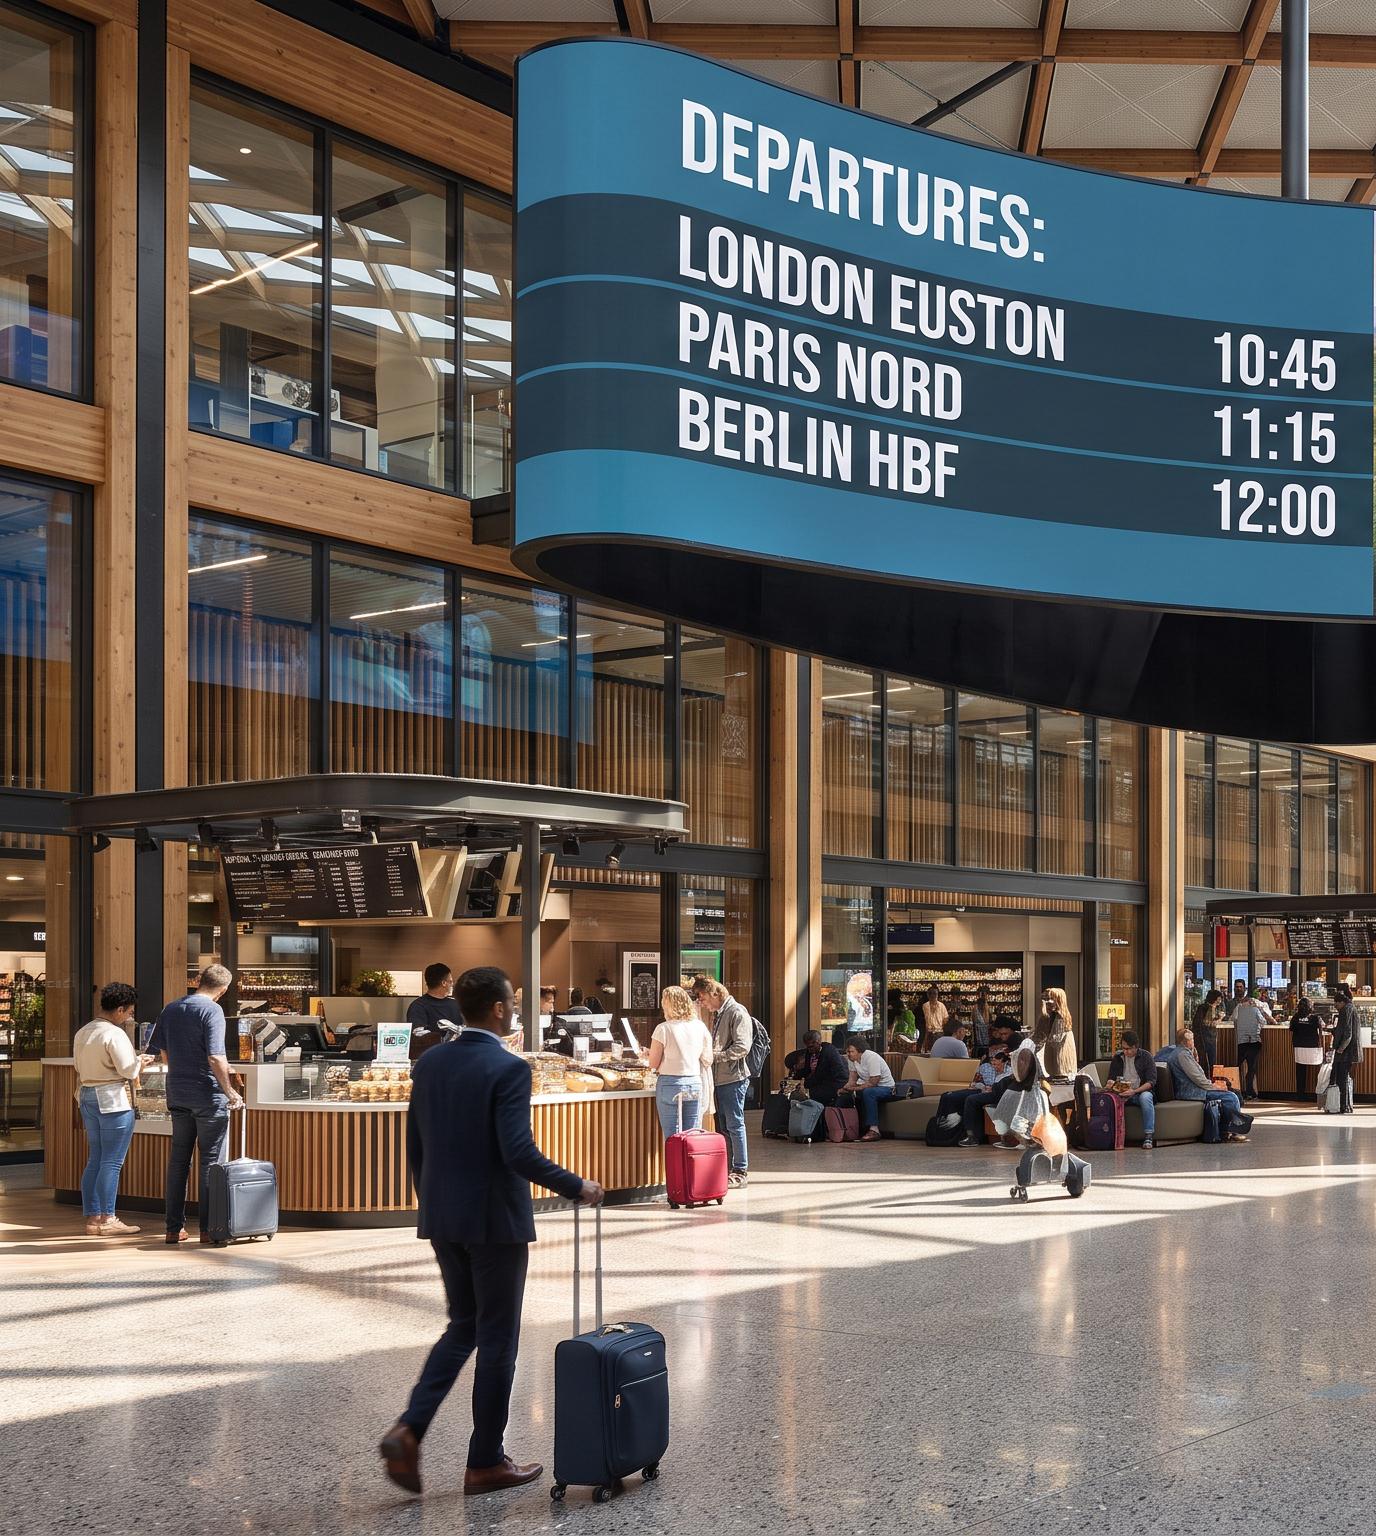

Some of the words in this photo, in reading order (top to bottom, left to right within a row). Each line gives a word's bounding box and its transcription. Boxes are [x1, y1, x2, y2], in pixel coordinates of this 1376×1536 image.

[682, 98, 1046, 263] DEPARTURES:
[679, 215, 874, 325] LONDON
[890, 275, 1066, 362] EUSTON
[1214, 331, 1336, 392] 10:45
[679, 302, 821, 393] PARIS
[836, 342, 962, 421] NORD
[1214, 405, 1336, 464] 11:15
[678, 387, 852, 483] BERLIN
[869, 430, 959, 498] HBF
[1213, 478, 1336, 537] 12:00
